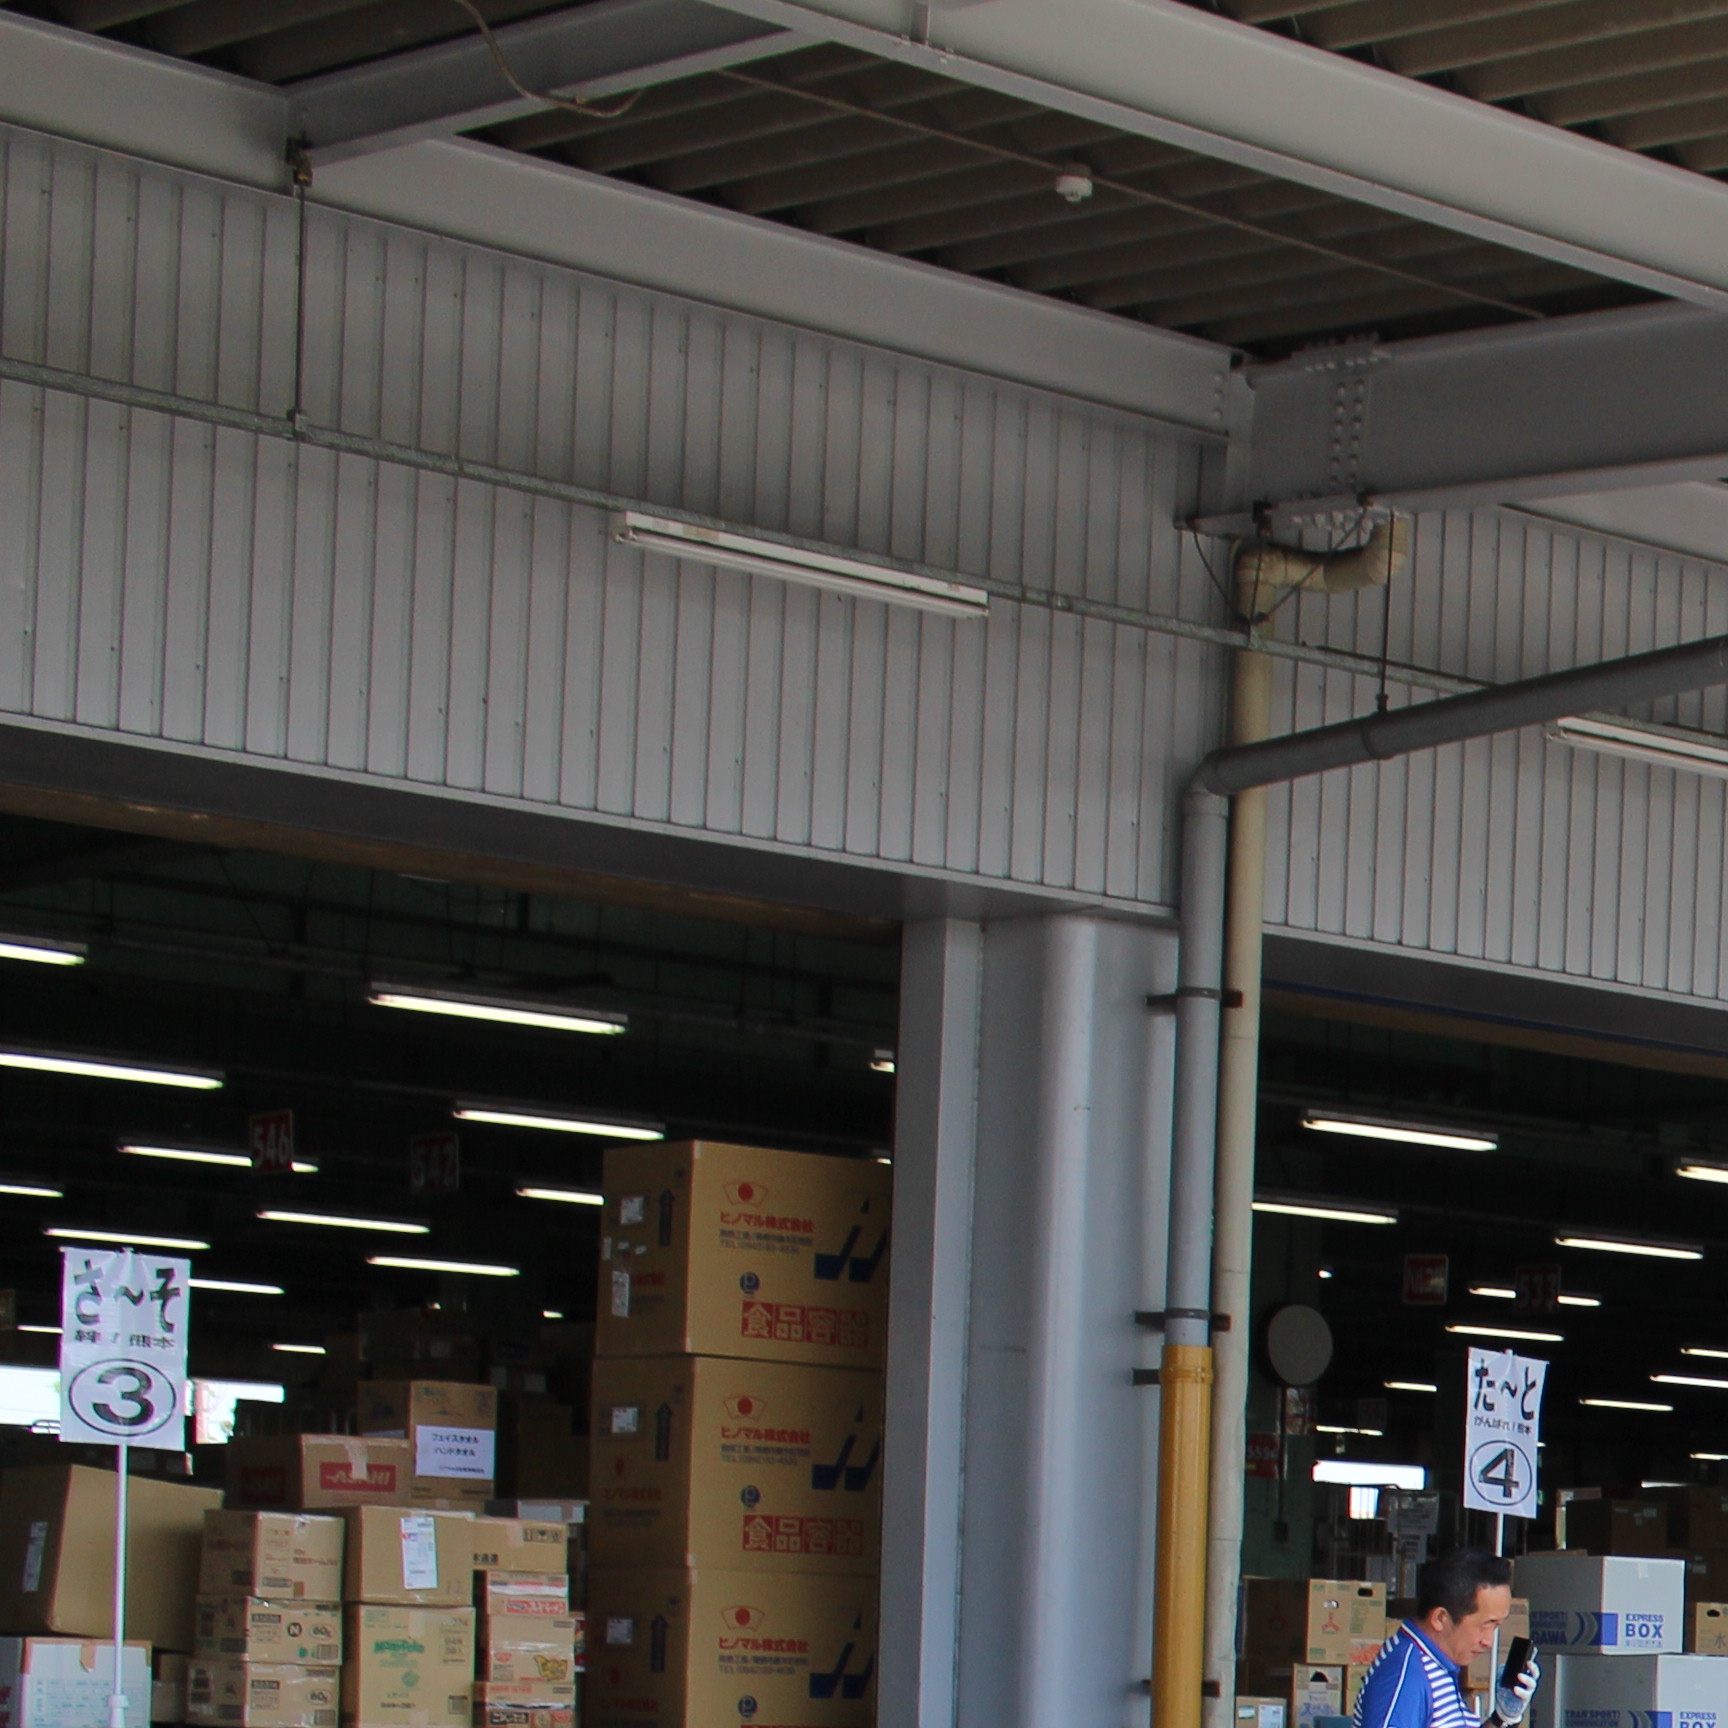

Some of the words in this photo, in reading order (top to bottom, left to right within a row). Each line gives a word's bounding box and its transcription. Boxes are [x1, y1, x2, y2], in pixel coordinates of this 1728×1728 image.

[92, 1366, 155, 1427] 3
[1479, 1449, 1519, 1498] 4
[1625, 1613, 1664, 1622] EXPRESS
[1625, 1624, 1663, 1639] BOX
[1680, 1711, 1716, 1720] EXPRESS
